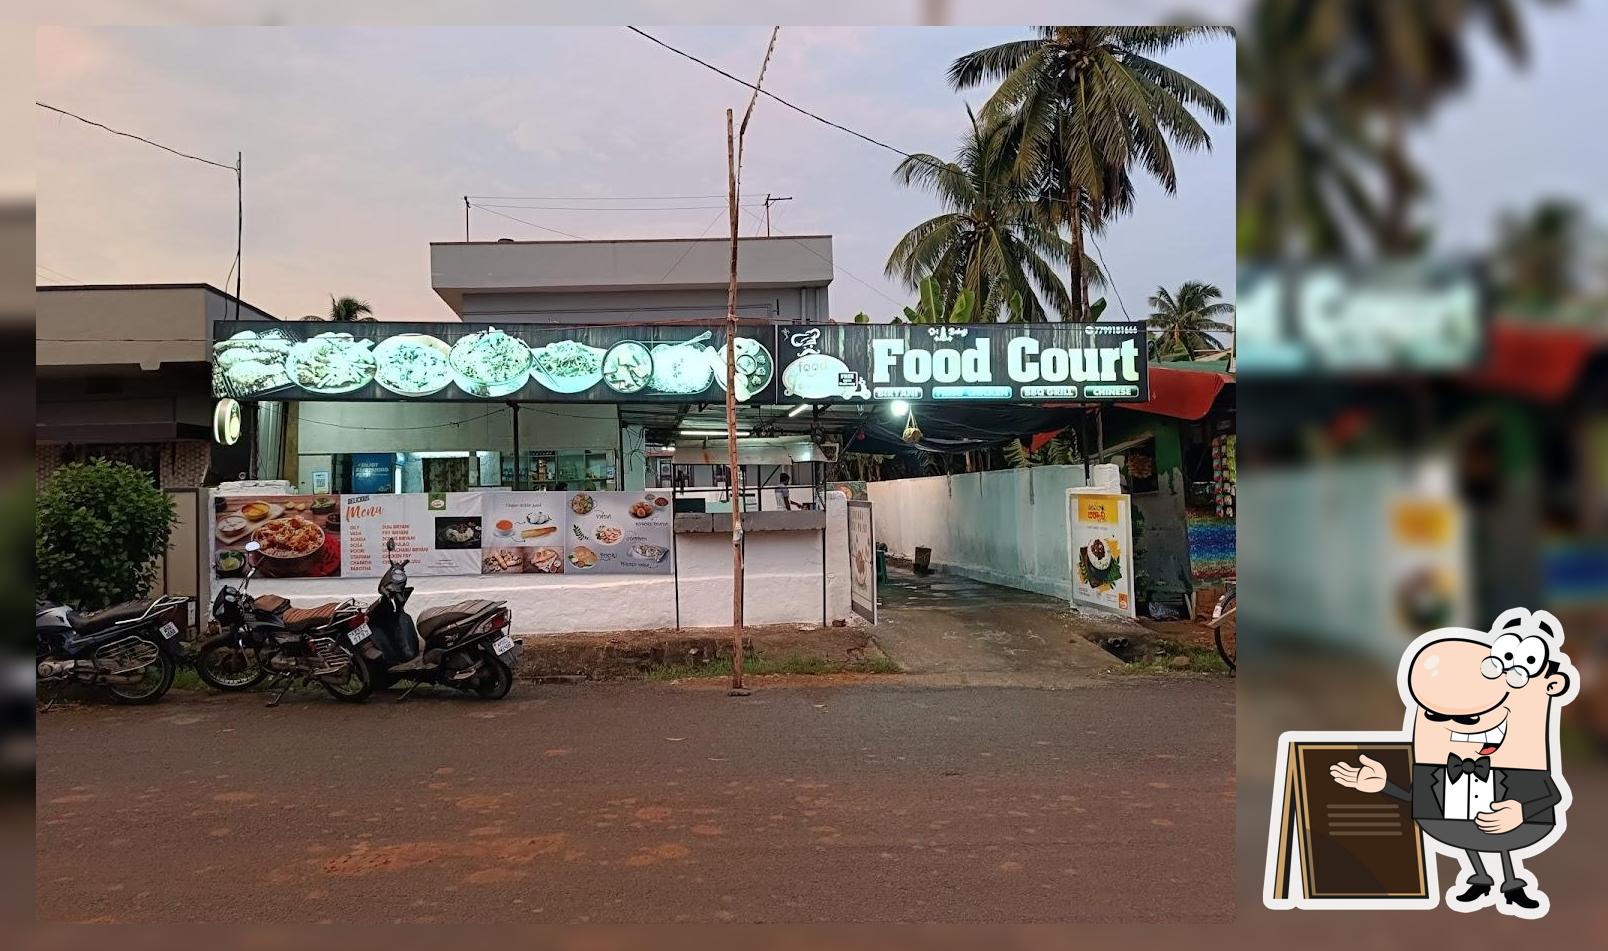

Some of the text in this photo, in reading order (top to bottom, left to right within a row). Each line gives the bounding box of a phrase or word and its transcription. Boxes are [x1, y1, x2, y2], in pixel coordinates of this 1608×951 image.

[873, 337, 1140, 383] Food Court
[1046, 387, 1073, 396] GRILL
[1092, 387, 1132, 396] CHINESE
[346, 505, 384, 522] Menu
